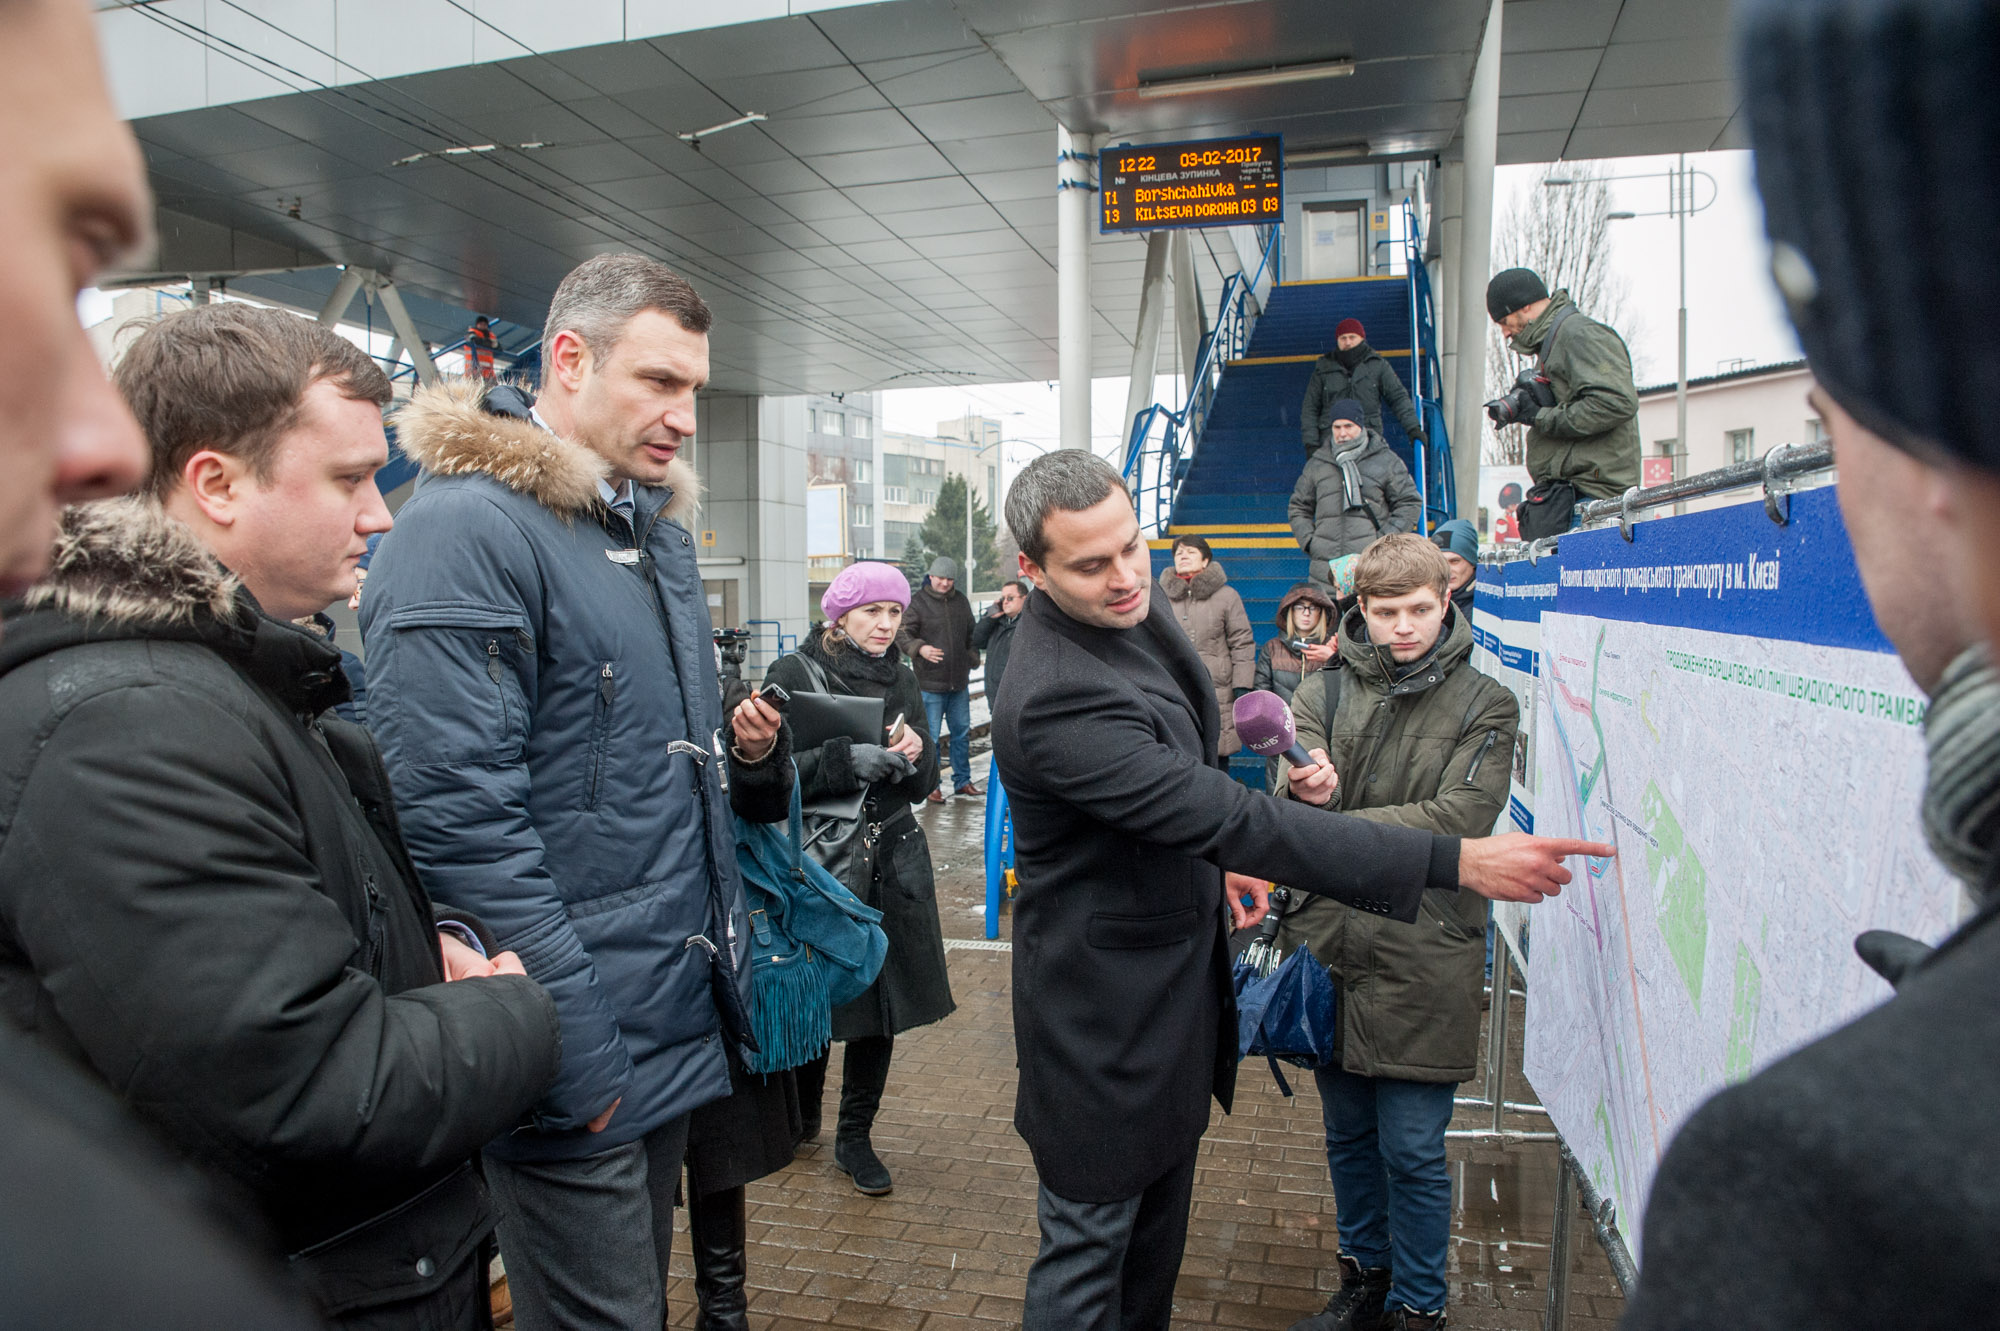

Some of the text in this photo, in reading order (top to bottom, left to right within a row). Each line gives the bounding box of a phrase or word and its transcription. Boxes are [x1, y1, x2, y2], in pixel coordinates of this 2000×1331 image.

[1180, 147, 1262, 167] 03-02-2017
[1140, 172, 1178, 183] КІНЦЕВА
[1180, 168, 1221, 180] ЗУПИНКА
[1135, 183, 1236, 203] Borshchahivka
[1105, 209, 1120, 224] 13
[1195, 201, 1239, 217] DOROHA
[1241, 199, 1257, 213] 03
[1263, 197, 1278, 212] 03
[1583, 562, 1621, 592] швидкісного
[1622, 566, 1672, 595] громадського
[1673, 563, 1724, 599] транспорту
[1725, 563, 1733, 589] в
[1734, 562, 1746, 589] м.
[1748, 549, 1780, 590] Києві
[1665, 649, 1707, 676] ПРОДОВЖЕННЯ
[1788, 674, 1867, 714] ШВИДКІСНОГО
[1870, 691, 1927, 726] ТРАМВА
